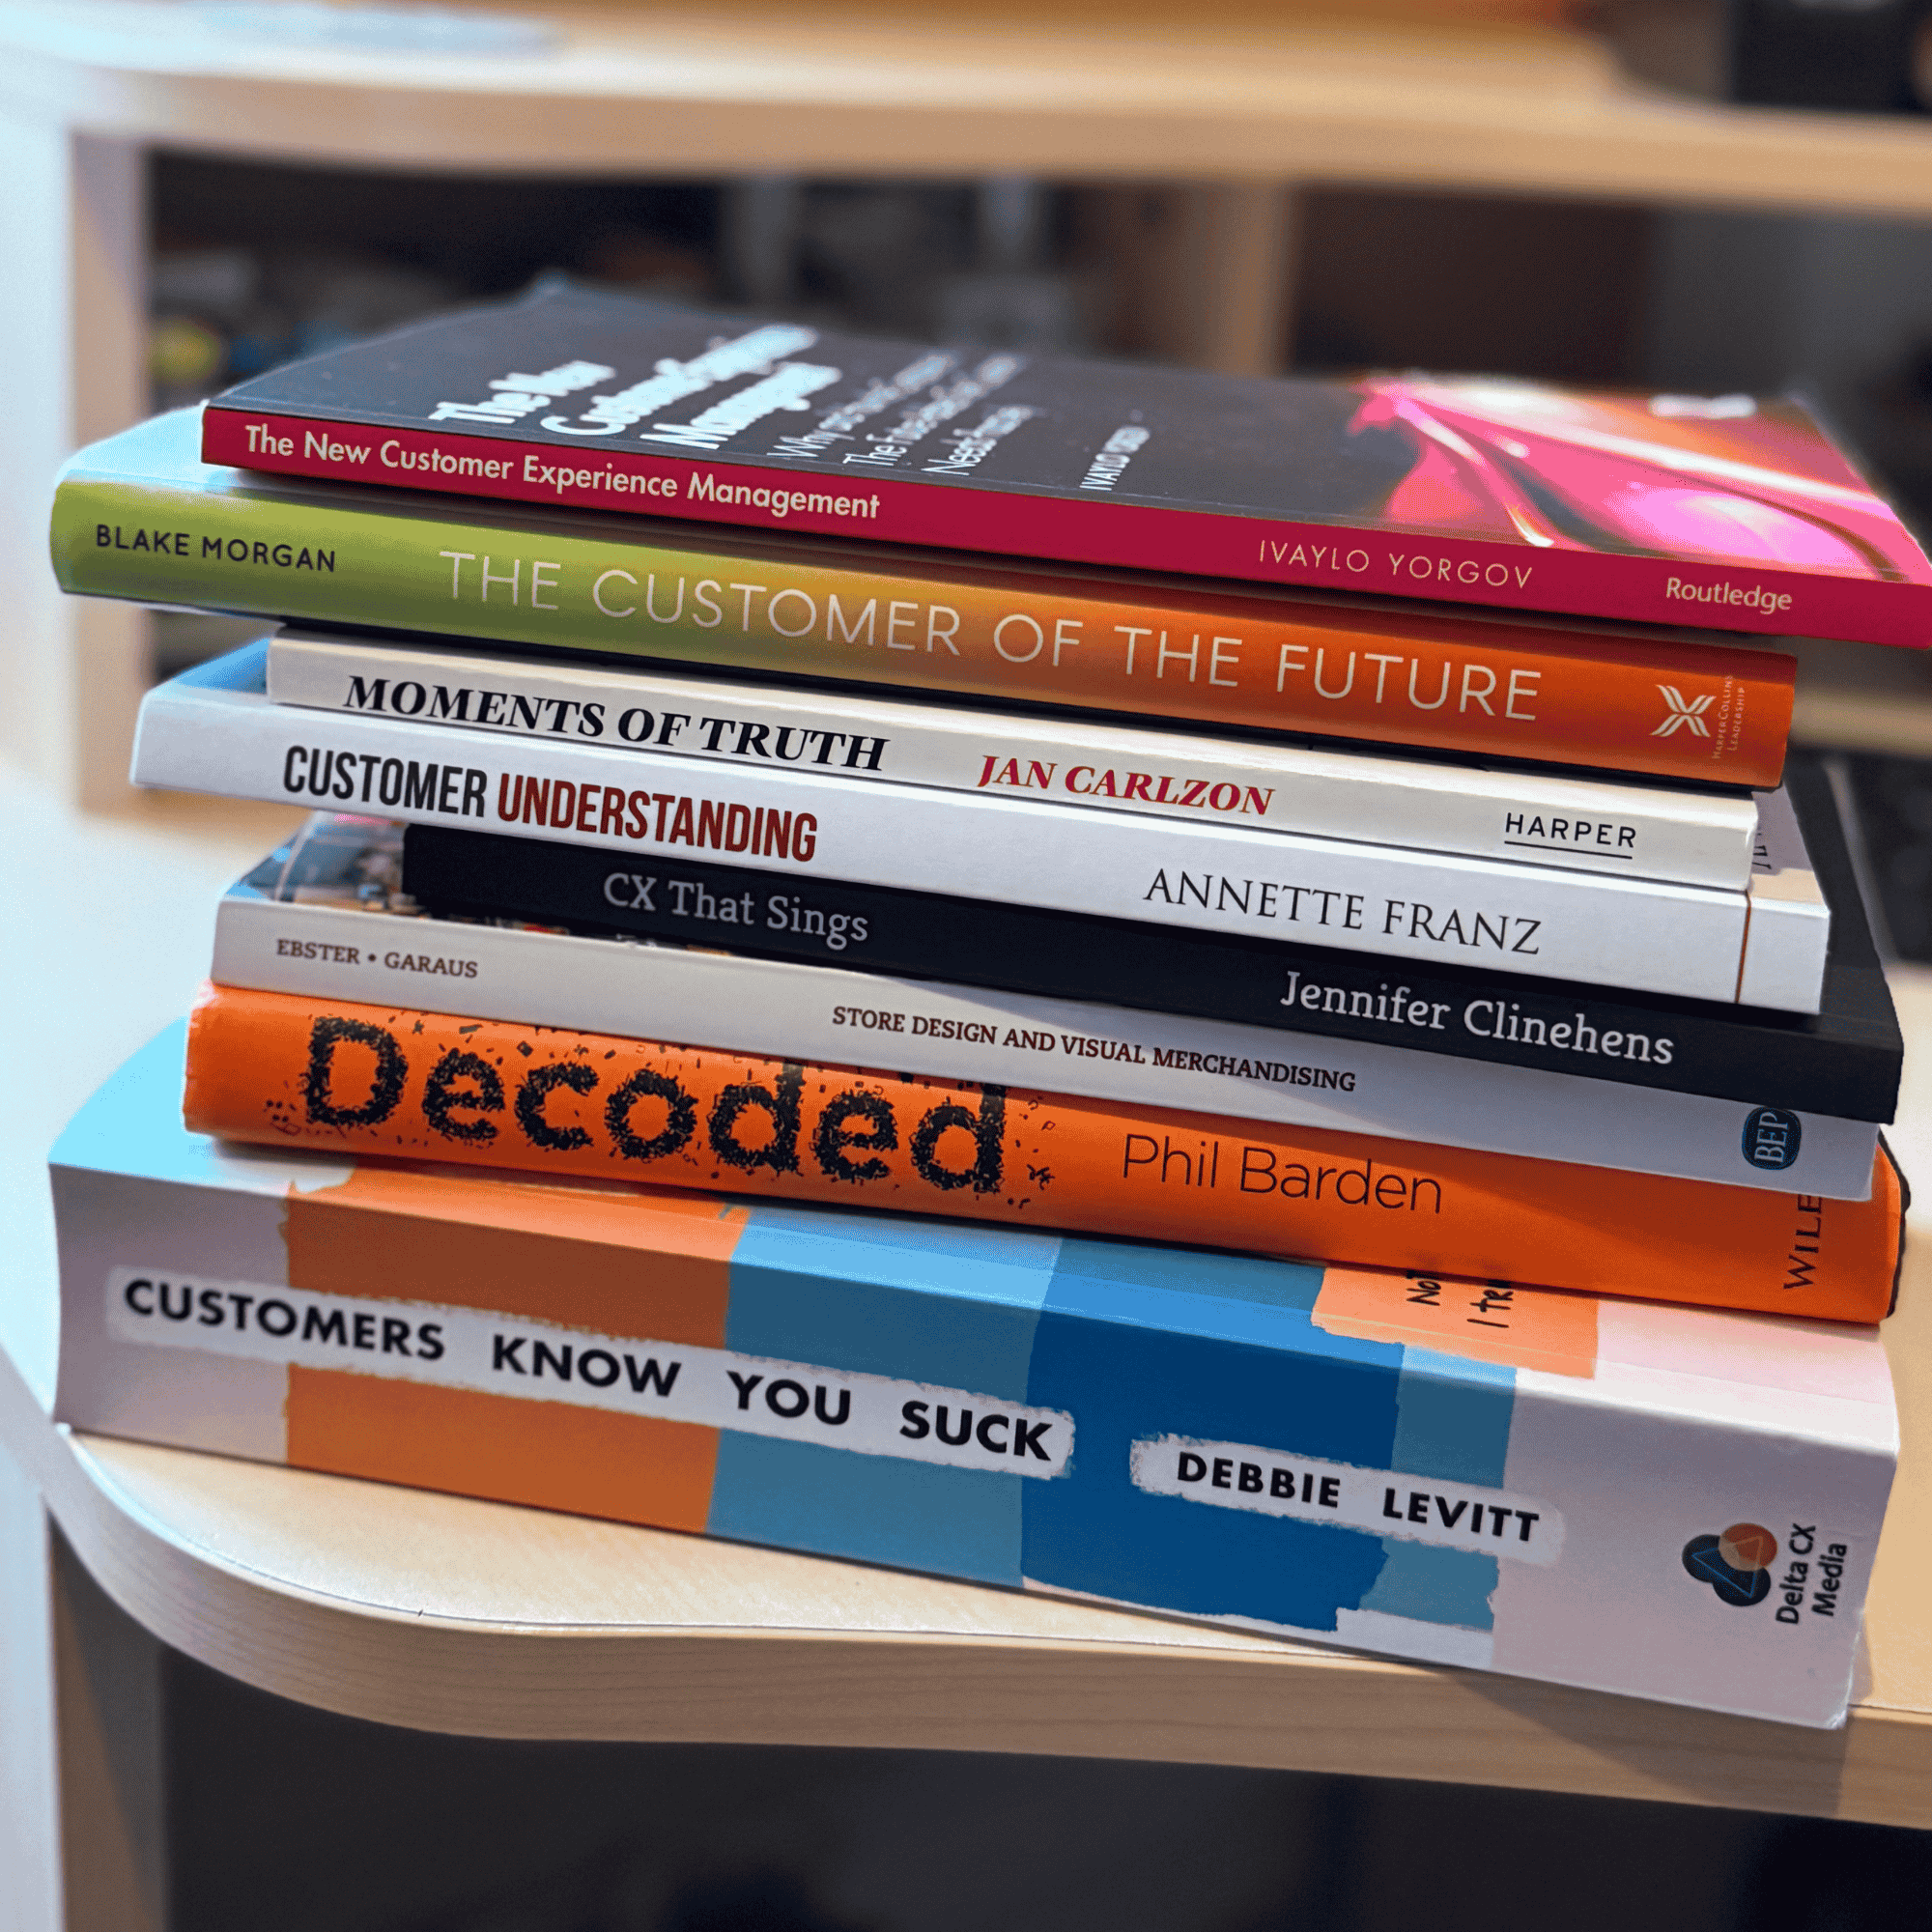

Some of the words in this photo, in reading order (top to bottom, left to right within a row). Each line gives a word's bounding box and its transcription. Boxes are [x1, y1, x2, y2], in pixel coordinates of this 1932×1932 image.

[244, 424, 294, 458] The
[304, 432, 371, 466] New
[380, 440, 515, 481] Customer
[523, 455, 679, 496] Experience
[687, 471, 880, 519] Management
[97, 525, 190, 556] BLAKE
[202, 535, 336, 573] MORGAN
[1259, 539, 1370, 573] IVAYLO
[1388, 554, 1533, 590] YORGOV
[1665, 577, 1793, 614] Routledge
[440, 551, 562, 611] THE
[593, 569, 960, 656] CUSTOMER
[993, 613, 1083, 667] OF
[1114, 625, 1243, 688] THE
[1277, 643, 1542, 722] FUTURE
[343, 675, 606, 738] MOMENTS
[617, 708, 691, 746] OF
[699, 718, 891, 772] TRUTH
[283, 745, 487, 818] CUSTOMER
[497, 773, 818, 863] UNDERSTANDING
[978, 755, 1058, 789] JAN
[1065, 766, 1275, 815] CARLZON
[1505, 812, 1637, 847] HARPER
[604, 872, 657, 911] CX
[668, 880, 755, 925] That
[767, 896, 869, 951] Sings
[1143, 868, 1365, 931] ANNETTE
[1381, 898, 1542, 955] FRANZ
[275, 938, 360, 965] EBSTER
[384, 952, 478, 980] GARAUS
[833, 1006, 905, 1034] STORE
[912, 1016, 997, 1046] DESIGN
[1003, 1027, 1056, 1053] AND
[1062, 1036, 1146, 1065] VISUAL
[1152, 1047, 1356, 1093] MERCHANDISING
[1280, 970, 1450, 1032] Jennifer
[1463, 999, 1675, 1065] Clinehens
[301, 1014, 1006, 1195] Decoded
[1753, 1111, 1789, 1164] BEP
[1122, 1133, 1219, 1189] Phil
[1238, 1147, 1442, 1214] Barden
[124, 1278, 445, 1360] CUSTOMERS
[492, 1333, 681, 1397] KNOW
[726, 1370, 851, 1425] YOU
[899, 1400, 1052, 1462] SUCK
[1178, 1452, 1342, 1508] DEBBIE
[1381, 1488, 1541, 1543] LEVITT
[1788, 1522, 1816, 1555] CX
[1776, 1561, 1809, 1625] Delta
[1811, 1543, 1847, 1617] Media
